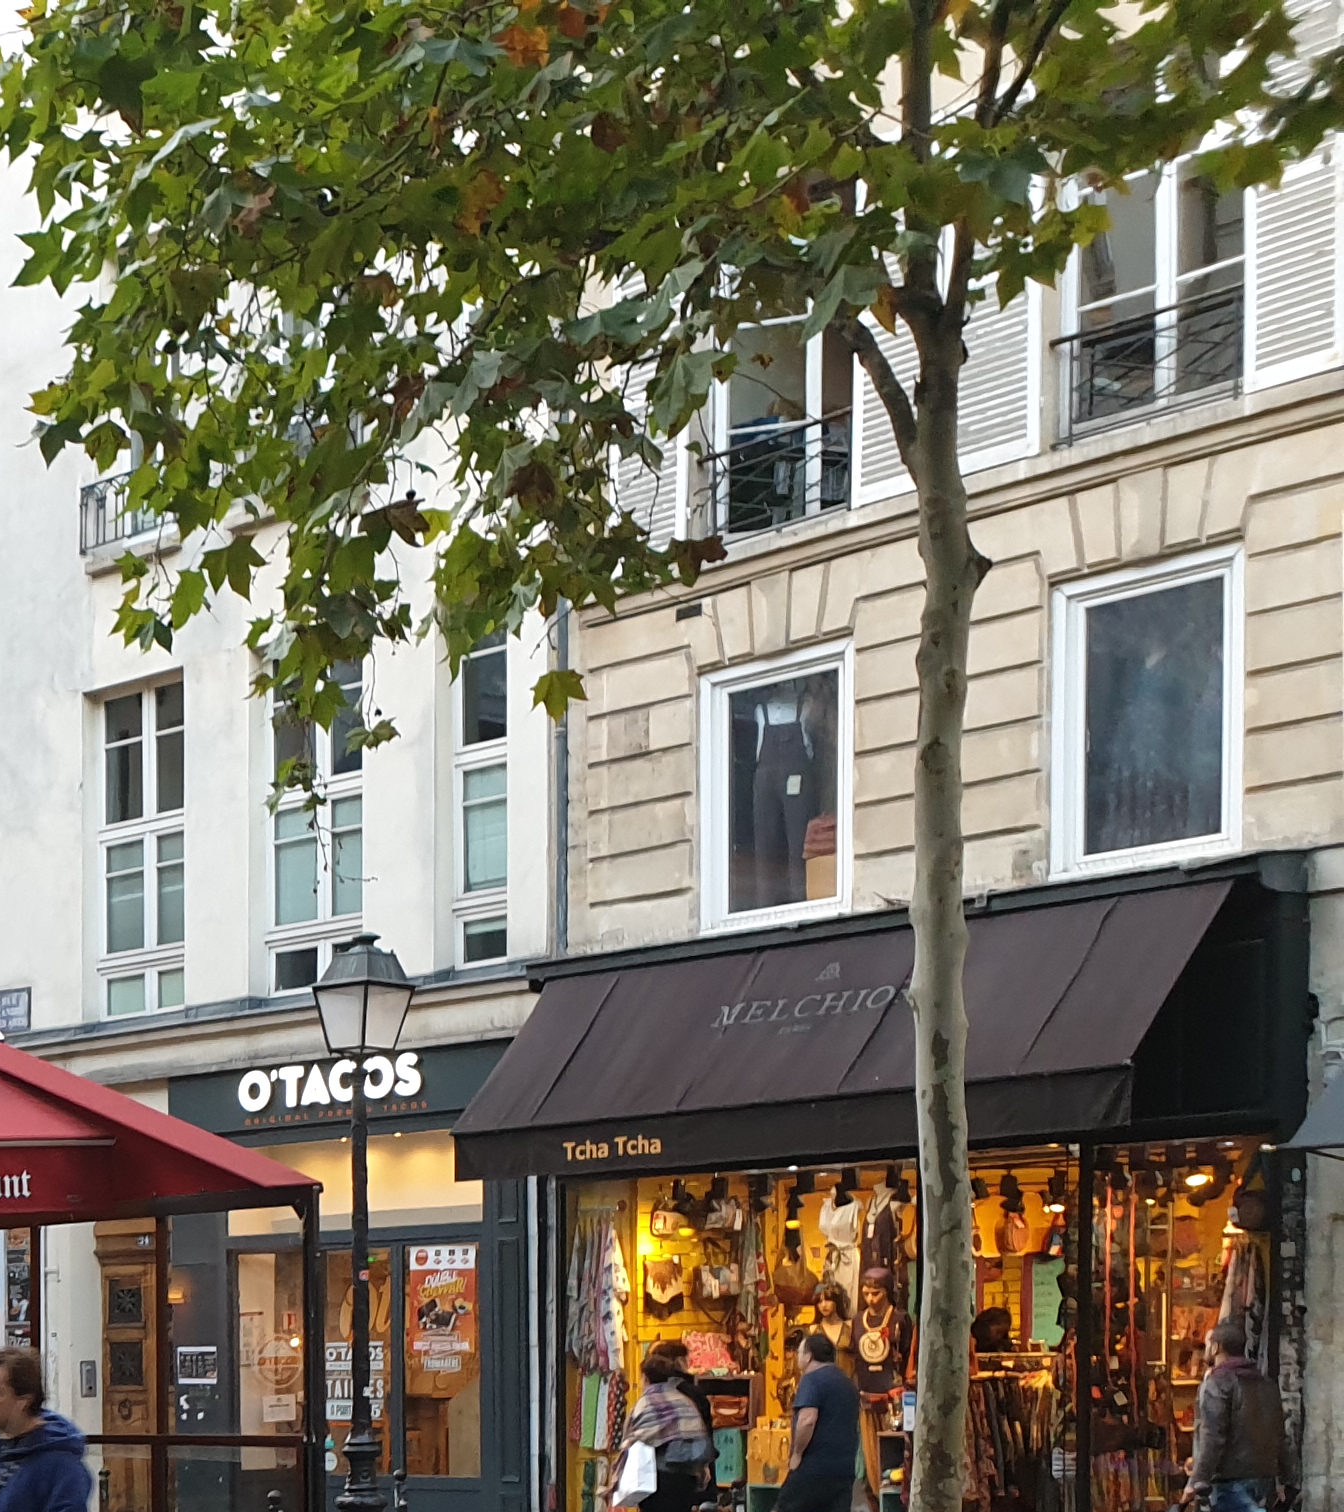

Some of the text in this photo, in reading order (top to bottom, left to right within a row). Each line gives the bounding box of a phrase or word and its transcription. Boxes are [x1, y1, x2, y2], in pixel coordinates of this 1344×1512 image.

[238, 1052, 422, 1112] O'TACOS
[562, 1133, 662, 1161] Tcha Tcha
